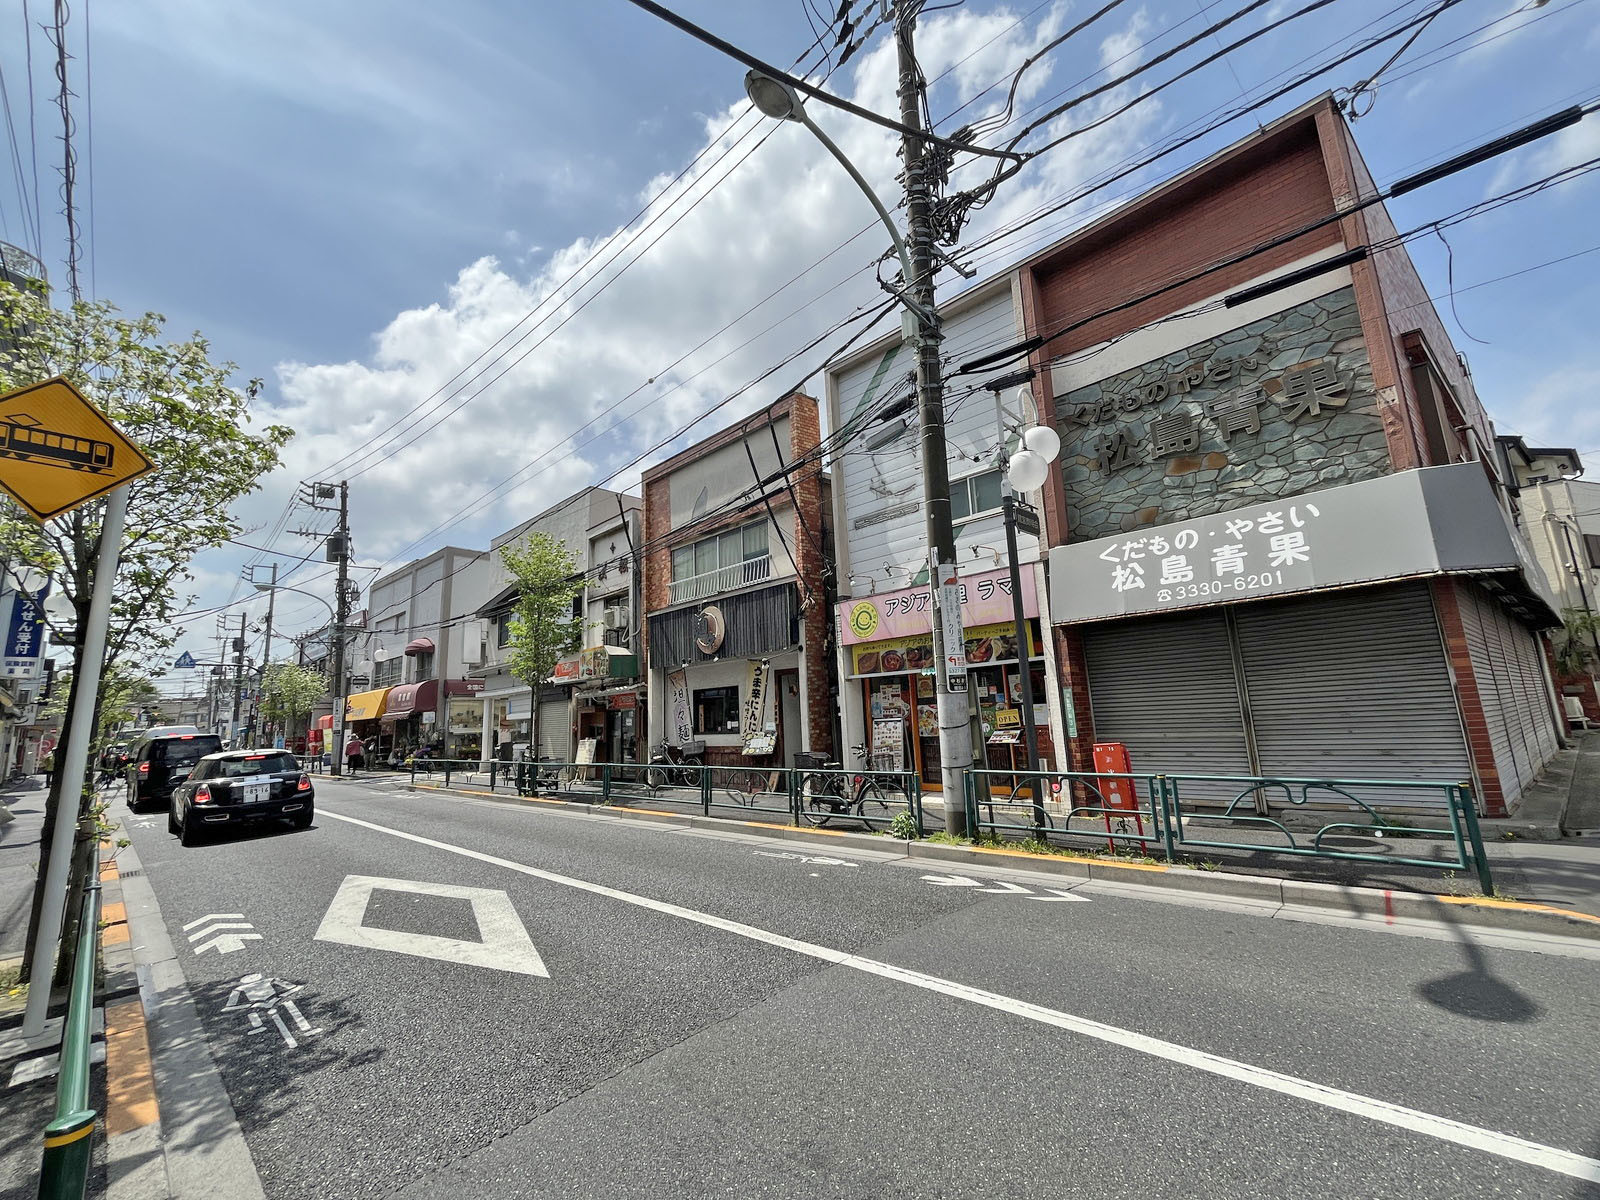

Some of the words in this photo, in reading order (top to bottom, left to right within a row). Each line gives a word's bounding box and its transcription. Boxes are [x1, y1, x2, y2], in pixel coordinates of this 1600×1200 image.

[1094, 361, 1346, 477] 松島青果
[1111, 531, 1311, 593] 松島青果
[1175, 570, 1284, 600] 3330-6201
[748, 666, 762, 733] うま辛にんに
[998, 714, 1018, 723] OPEN
